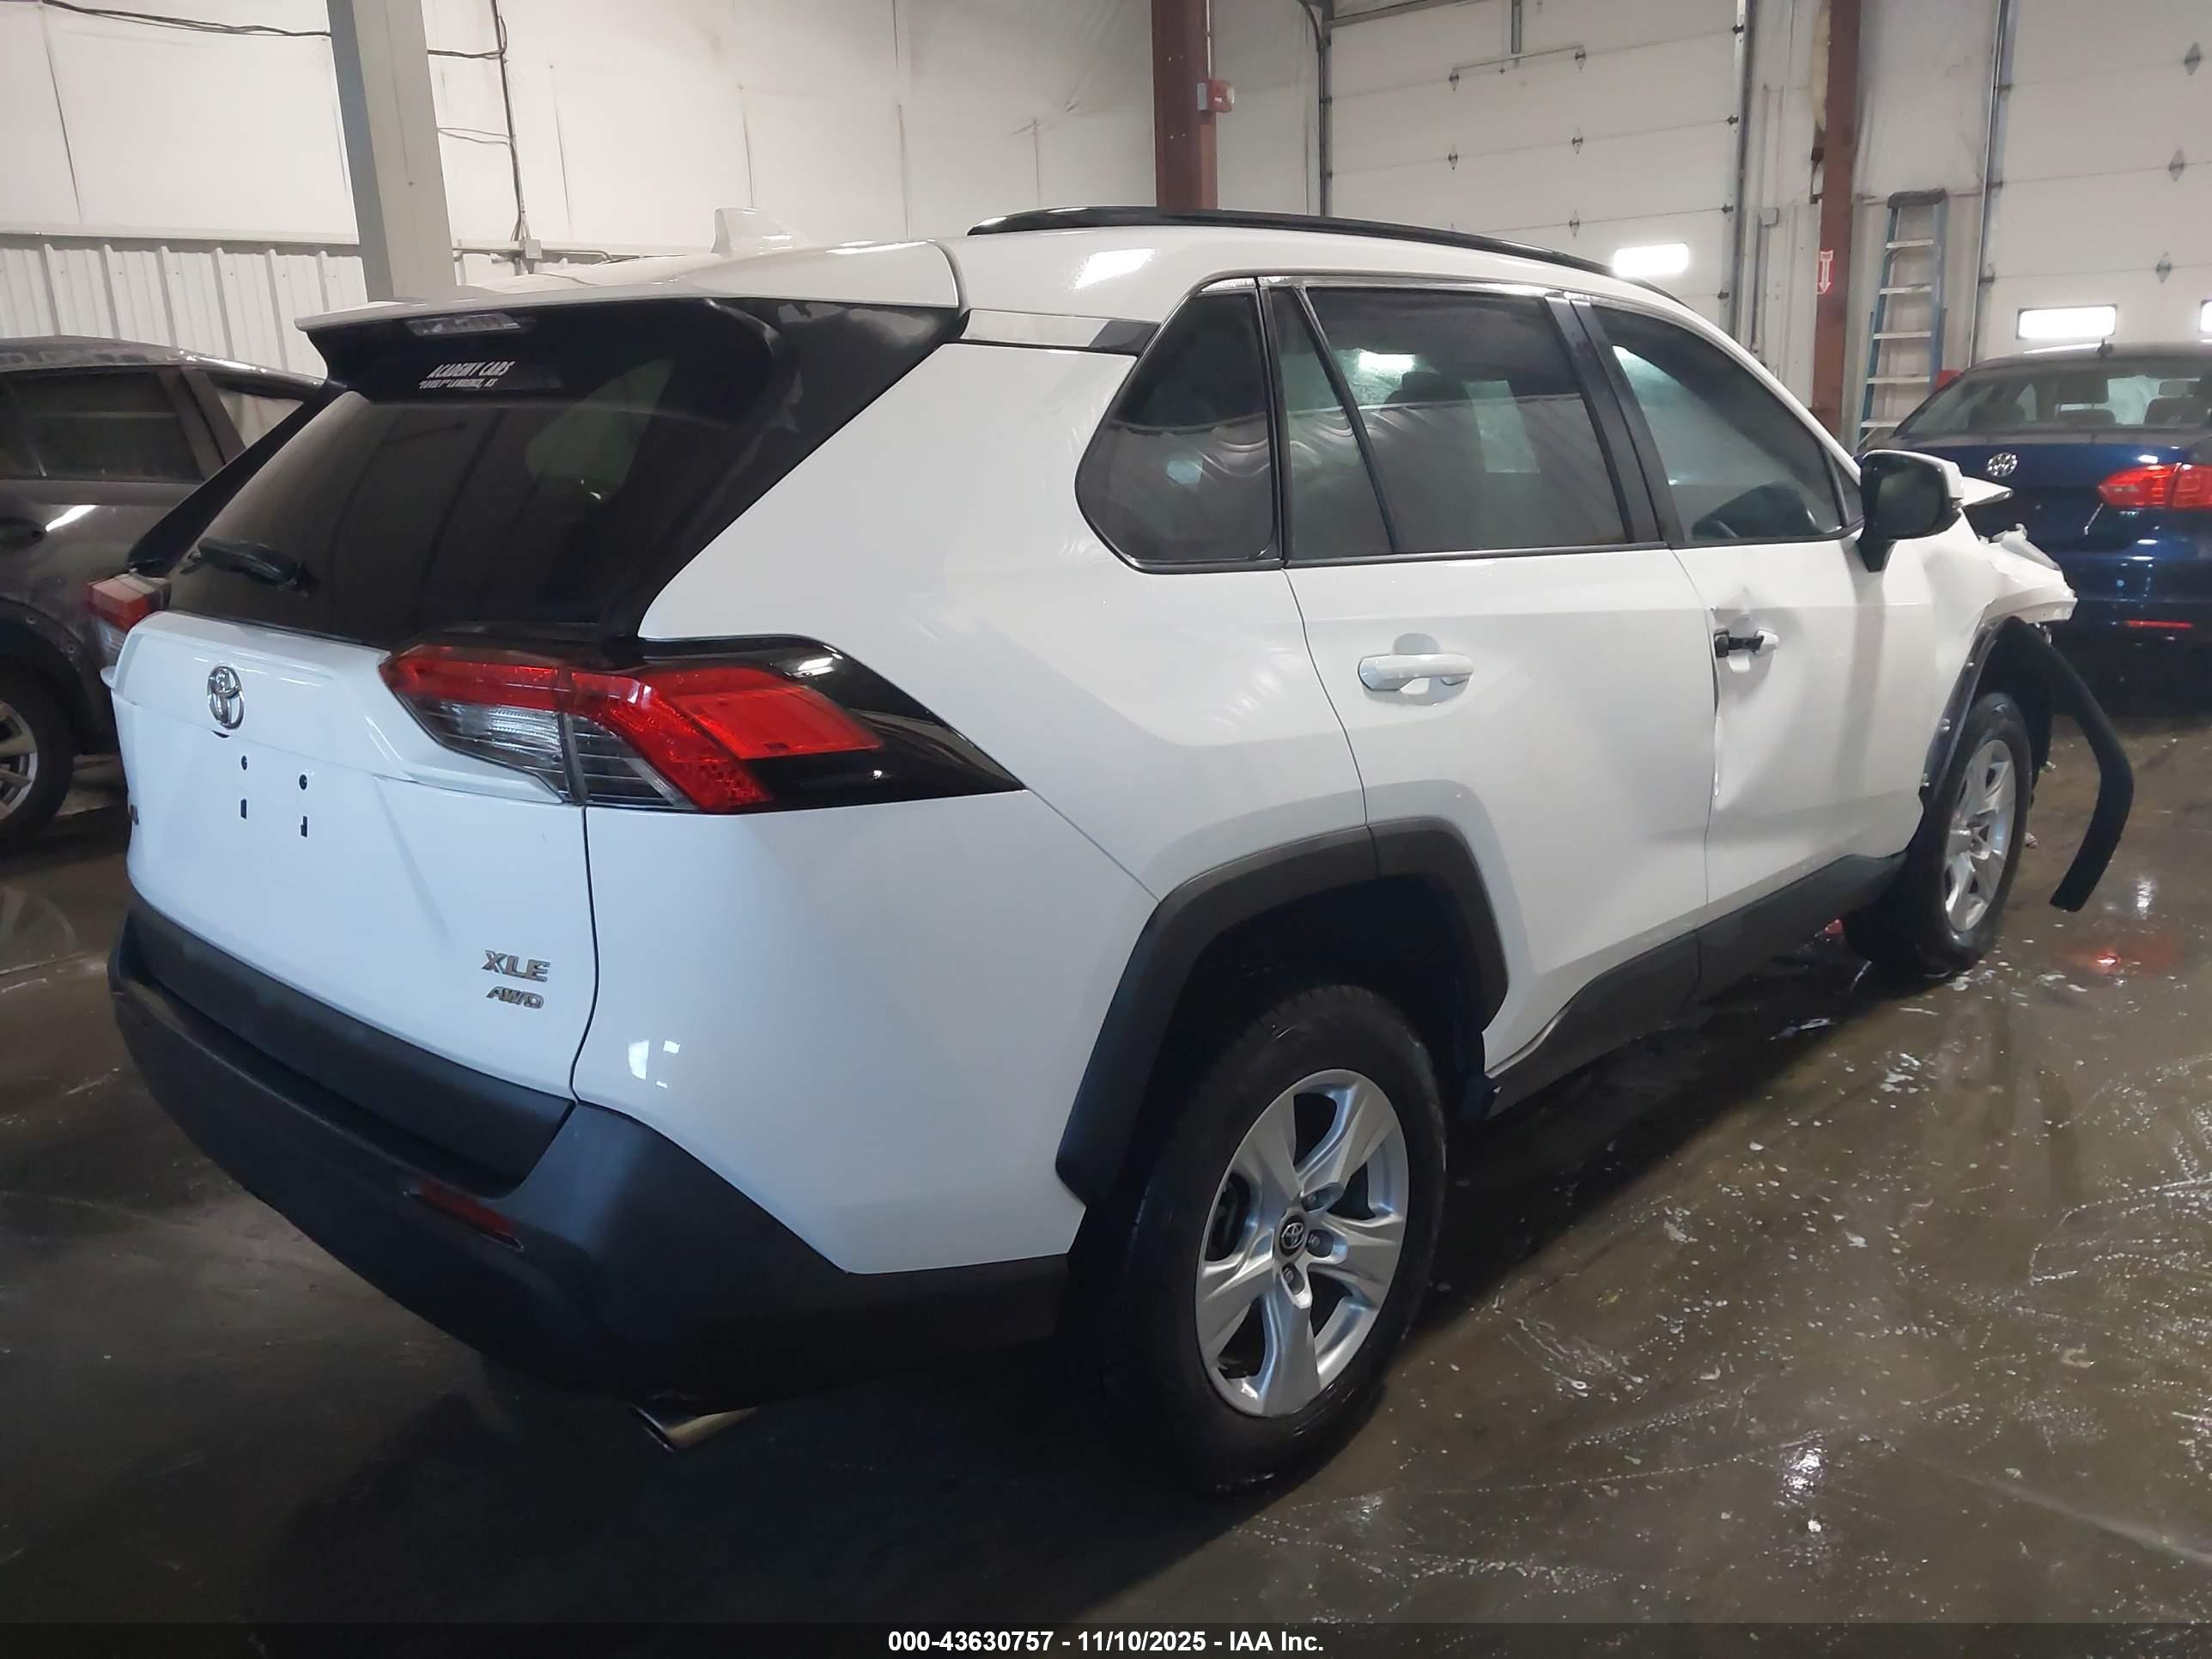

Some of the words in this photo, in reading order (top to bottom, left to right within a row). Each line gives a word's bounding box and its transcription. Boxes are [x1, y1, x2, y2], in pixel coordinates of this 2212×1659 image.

[478, 361, 515, 376] CARS
[481, 950, 550, 982] XLE
[486, 986, 544, 1009] AWD
